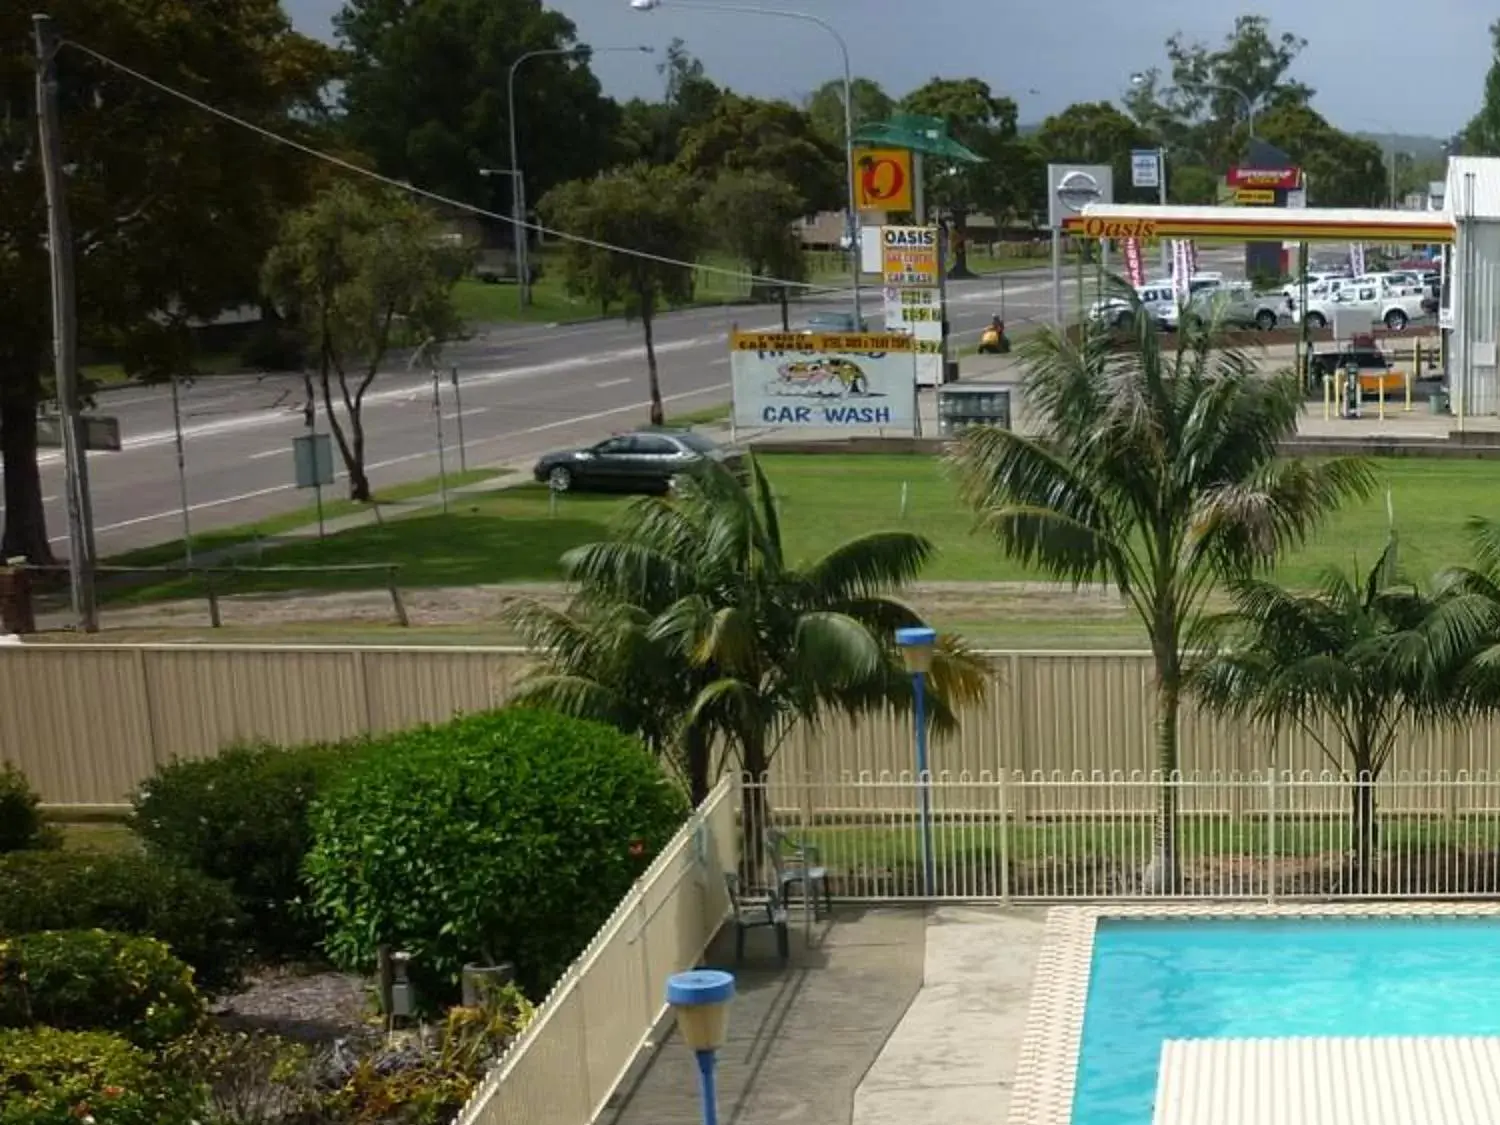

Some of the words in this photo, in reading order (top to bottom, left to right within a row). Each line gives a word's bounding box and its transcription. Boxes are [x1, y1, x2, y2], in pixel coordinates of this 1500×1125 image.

[1086, 217, 1155, 237] Oasis
[885, 230, 934, 245] OASIS
[763, 406, 812, 422] CAR
[825, 406, 890, 423] WASH
